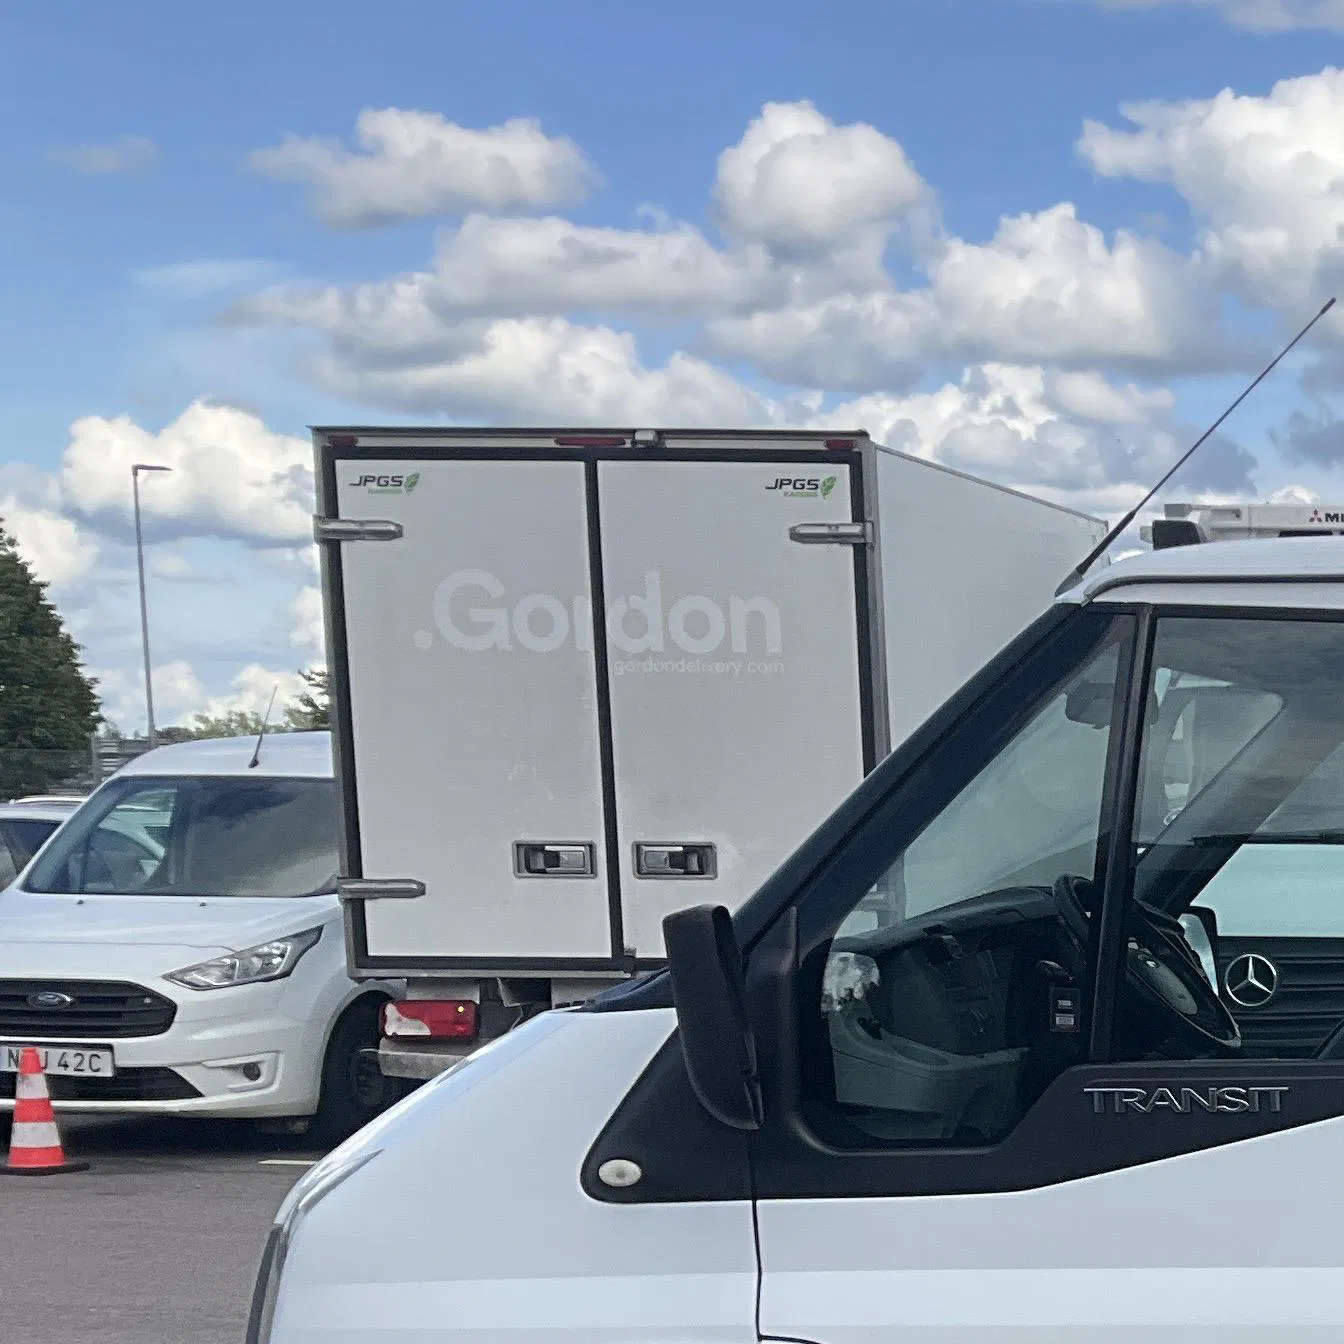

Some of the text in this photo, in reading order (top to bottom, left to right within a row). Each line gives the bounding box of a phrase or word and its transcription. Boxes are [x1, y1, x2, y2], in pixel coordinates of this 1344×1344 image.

[348, 475, 404, 487] JPGS
[765, 478, 821, 490] JPGS
[57, 1051, 101, 1073] 42C
[1083, 1087, 1289, 1113] TRANSIT
